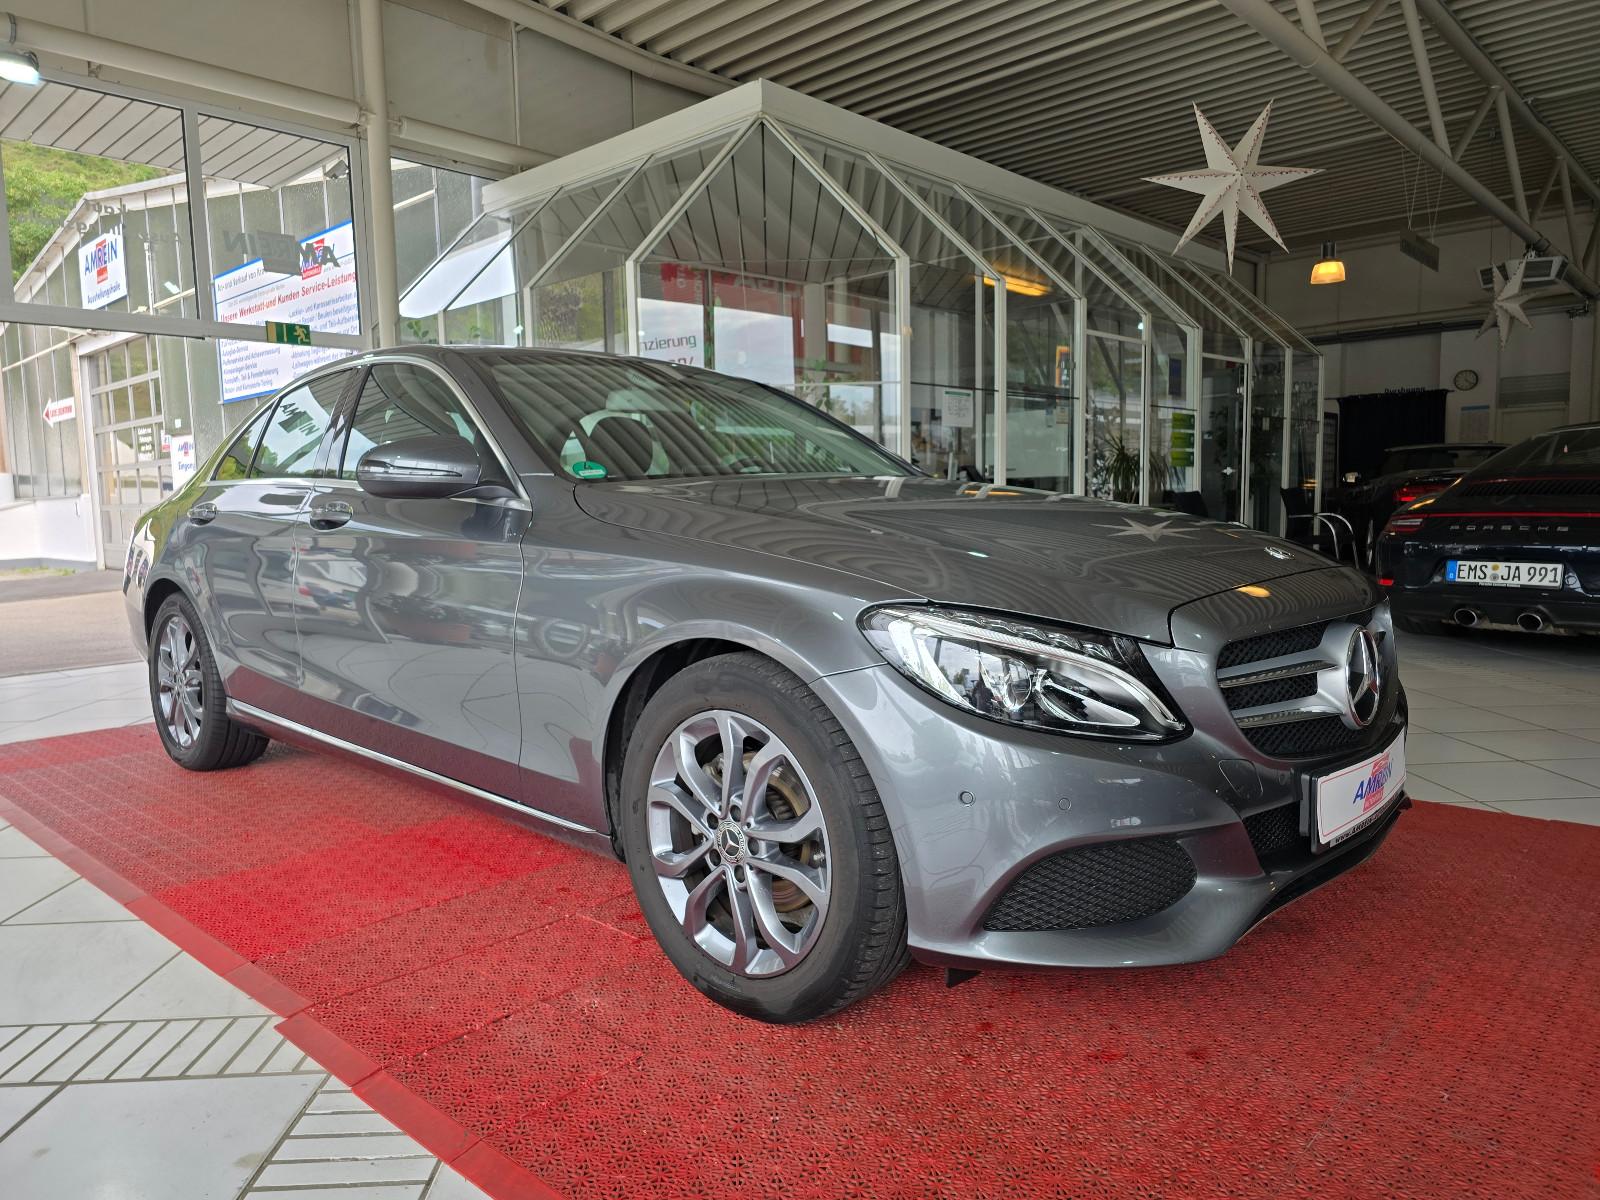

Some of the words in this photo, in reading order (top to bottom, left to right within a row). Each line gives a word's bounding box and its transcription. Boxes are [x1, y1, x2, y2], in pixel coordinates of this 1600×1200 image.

[85, 239, 118, 275] AMREIN
[278, 289, 300, 304] Kunden
[1457, 563, 1488, 580] EMS
[1501, 565, 1521, 582] JA
[1527, 566, 1559, 583] 991
